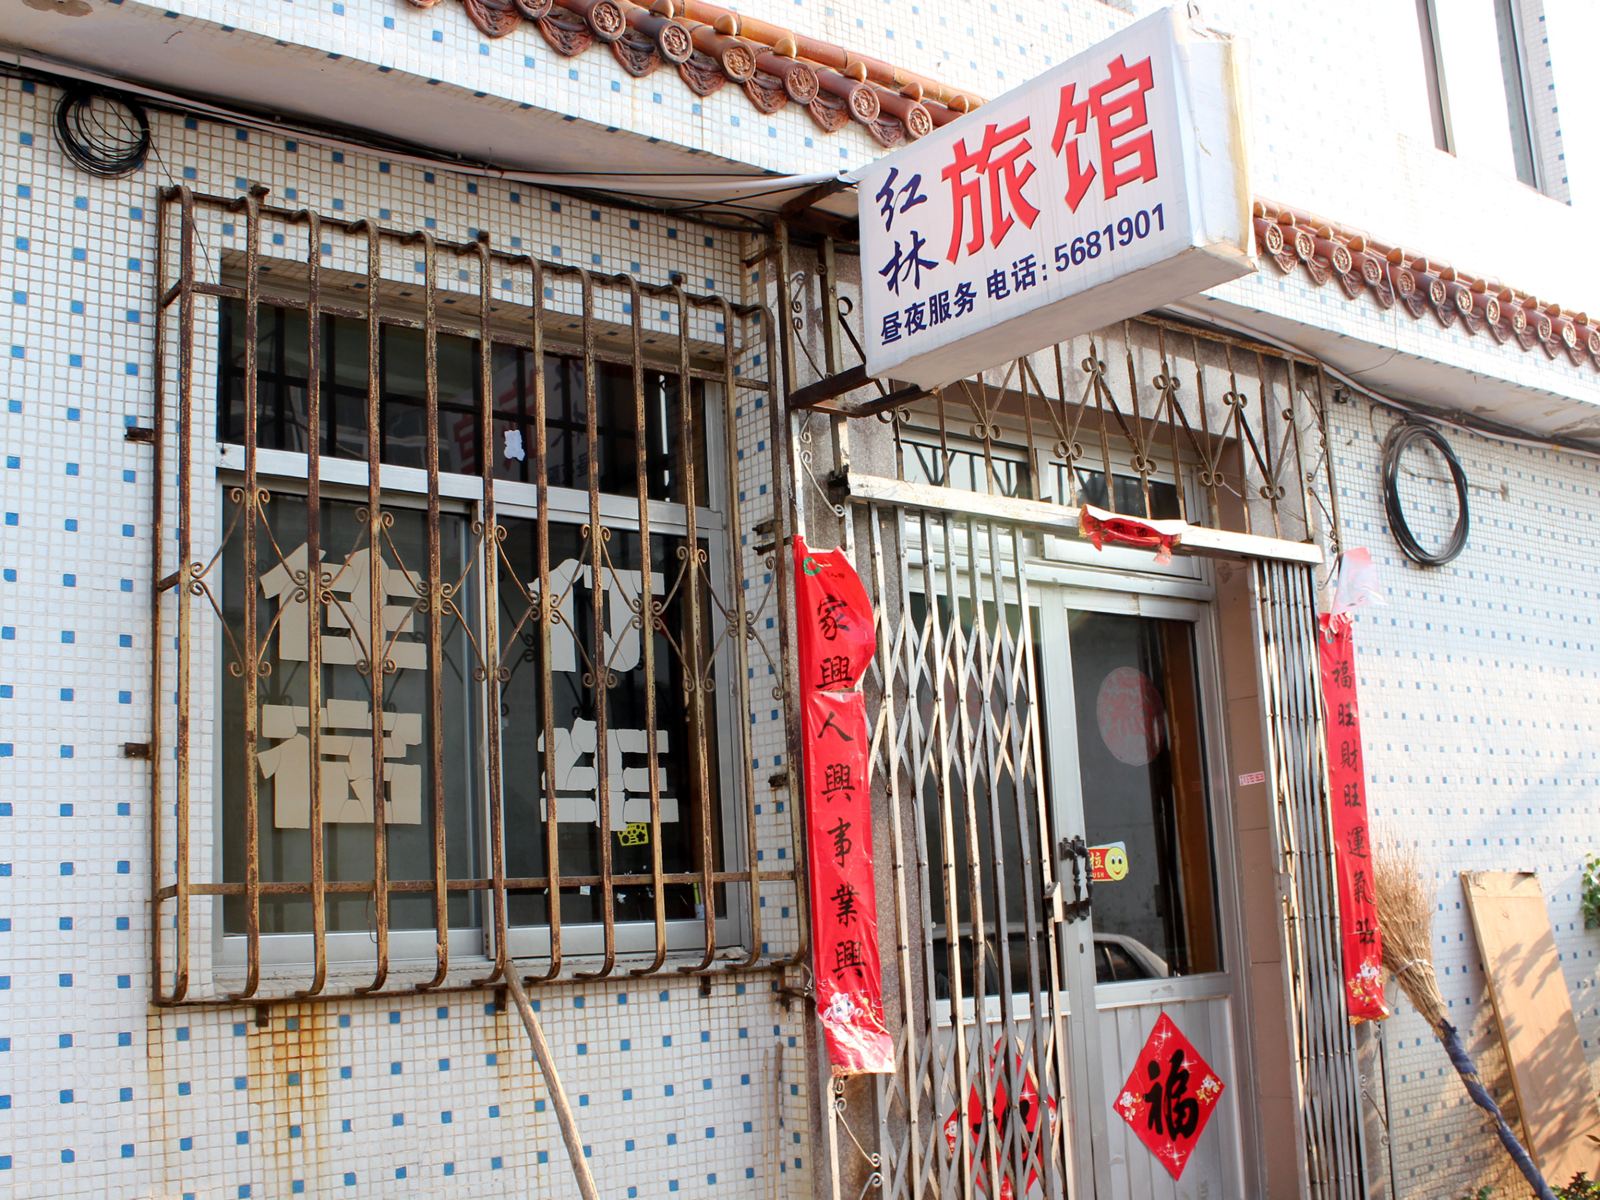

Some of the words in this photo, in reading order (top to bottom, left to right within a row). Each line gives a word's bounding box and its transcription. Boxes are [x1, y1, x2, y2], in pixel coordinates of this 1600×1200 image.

[941, 53, 1159, 265] 旅馆
[875, 166, 938, 297] 红林
[881, 280, 978, 345] 昼夜服务
[1144, 1049, 1199, 1141] 福
